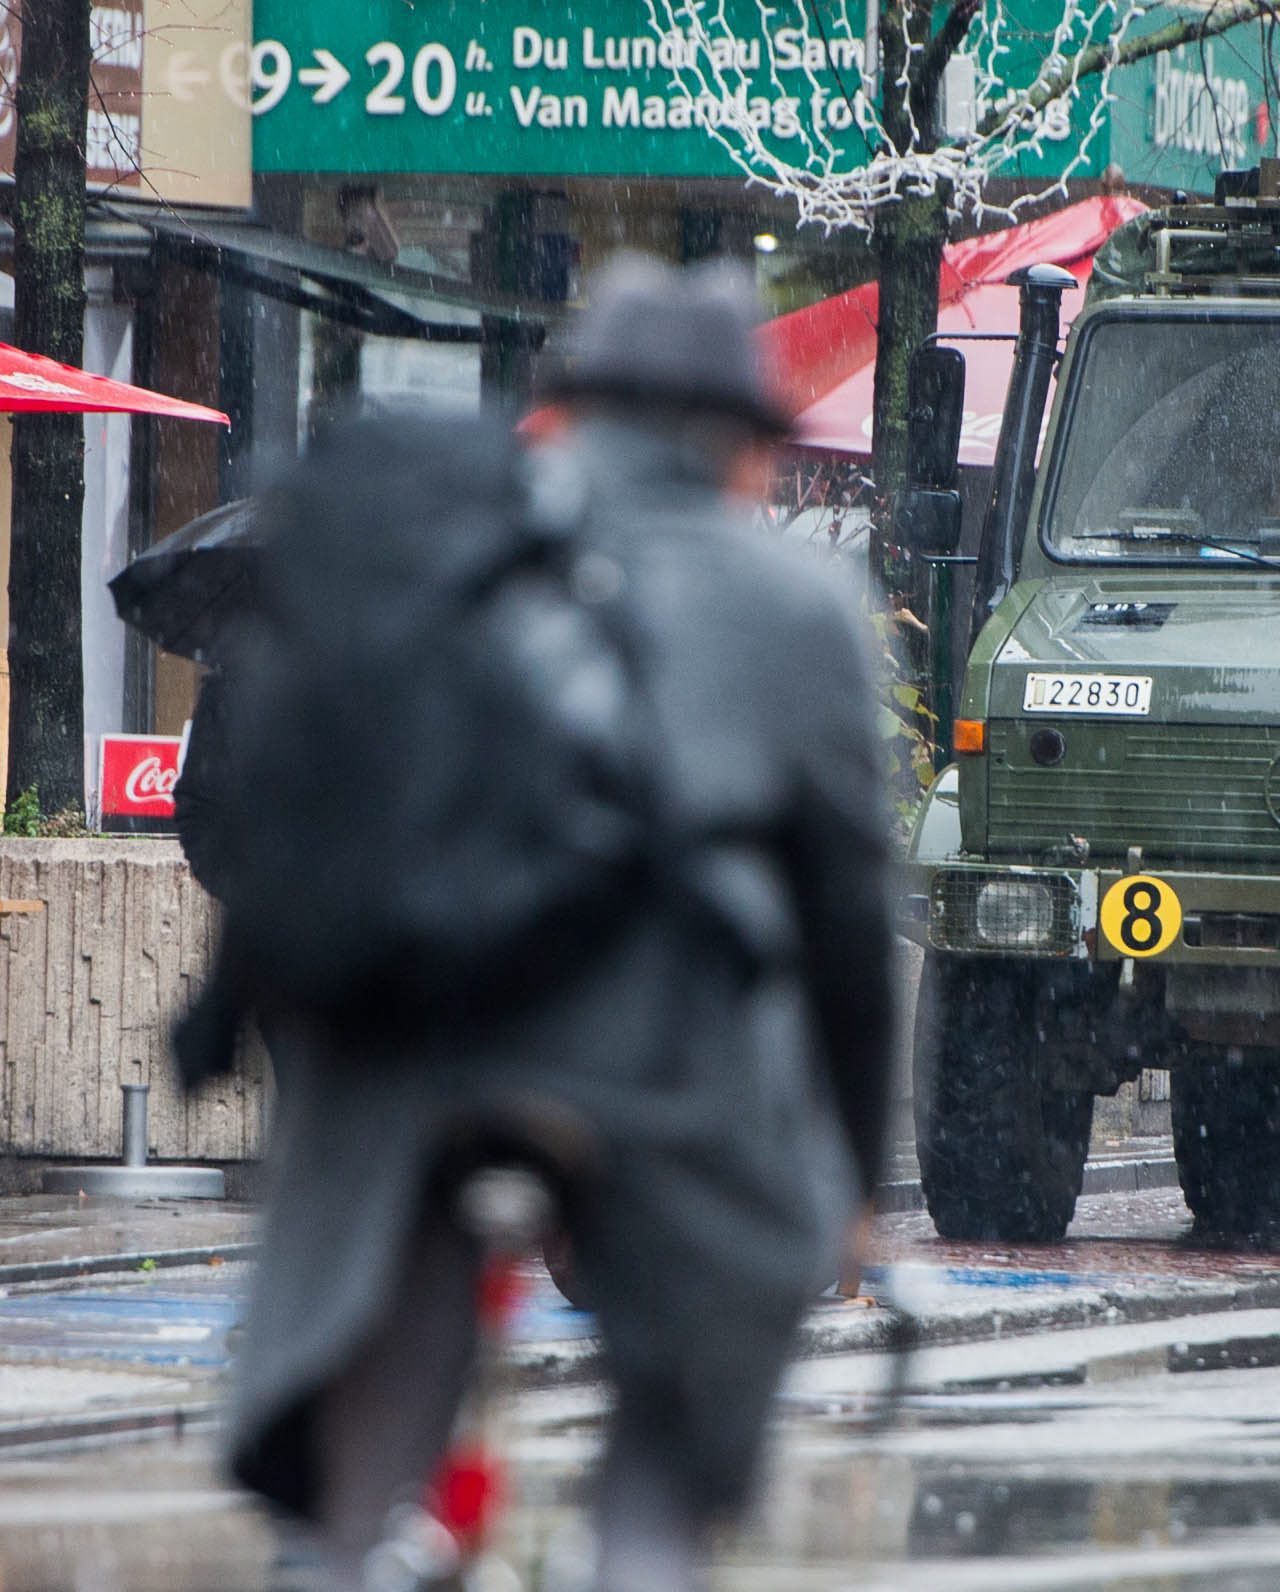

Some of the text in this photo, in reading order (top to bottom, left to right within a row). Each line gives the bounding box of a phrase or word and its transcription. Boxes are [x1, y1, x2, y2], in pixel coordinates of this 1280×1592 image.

[464, 39, 494, 71] h.
[513, 26, 568, 69] Du
[583, 26, 699, 69] Lundi
[711, 38, 760, 69] au
[251, 39, 457, 116] 9 20
[464, 91, 494, 116] u.
[509, 85, 588, 128] Van
[601, 85, 799, 139] Maandag
[810, 86, 877, 131] tot
[1049, 680, 1140, 707] 22830
[1121, 882, 1163, 952] 8
